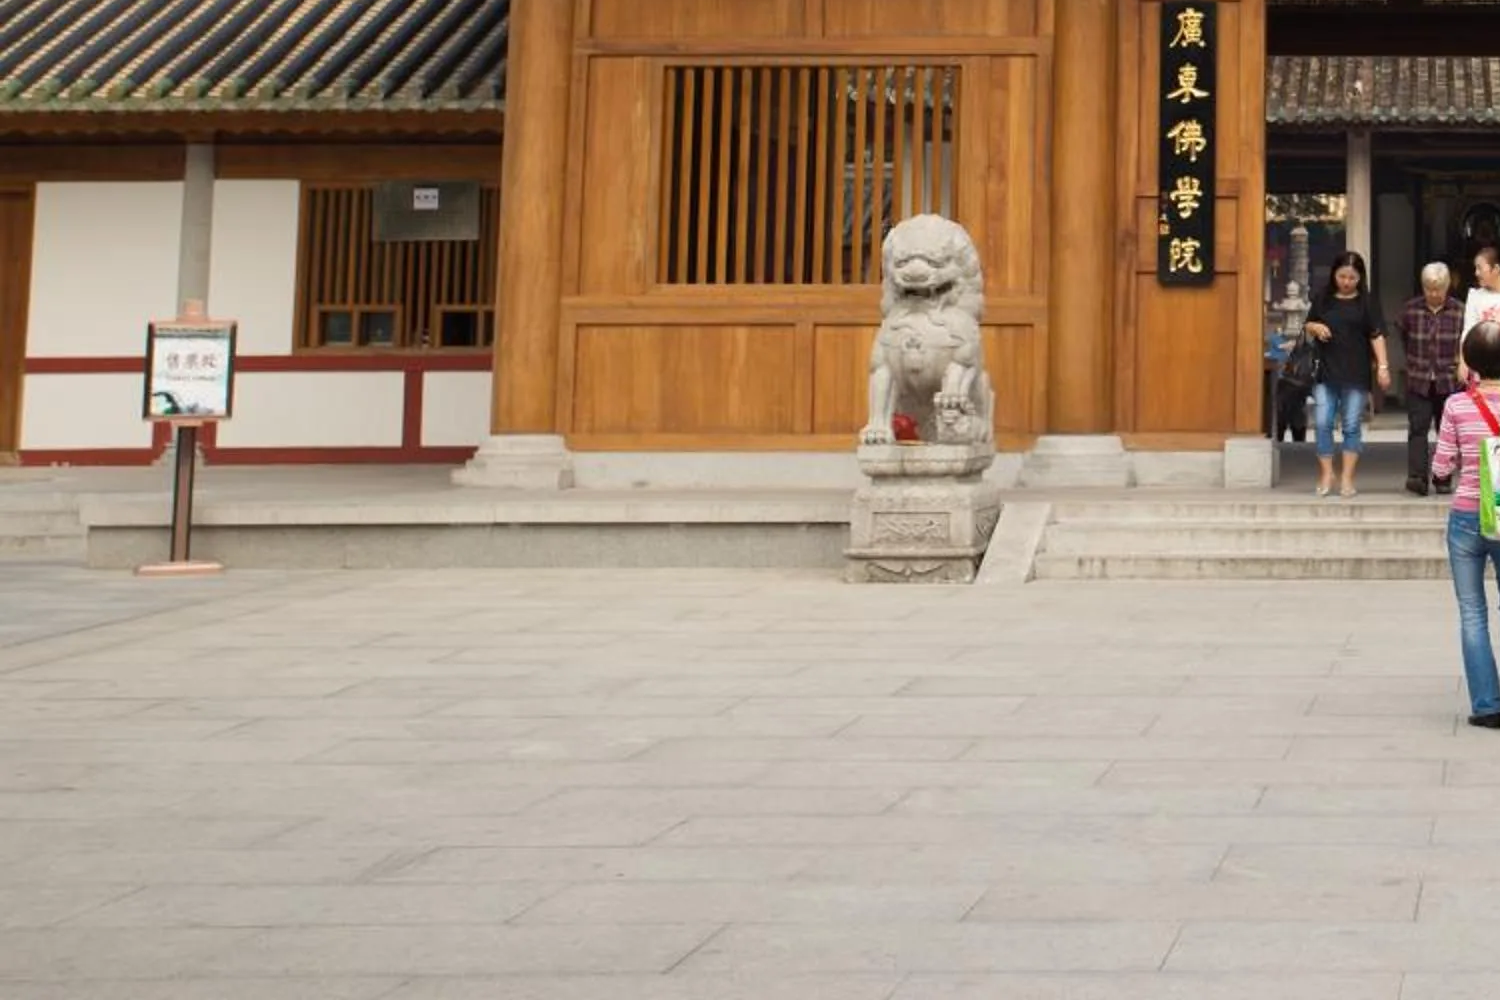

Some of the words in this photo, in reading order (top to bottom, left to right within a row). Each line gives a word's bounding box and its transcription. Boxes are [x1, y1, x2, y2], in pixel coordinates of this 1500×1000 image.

[1166, 7, 1210, 273] 廣東佛學院
